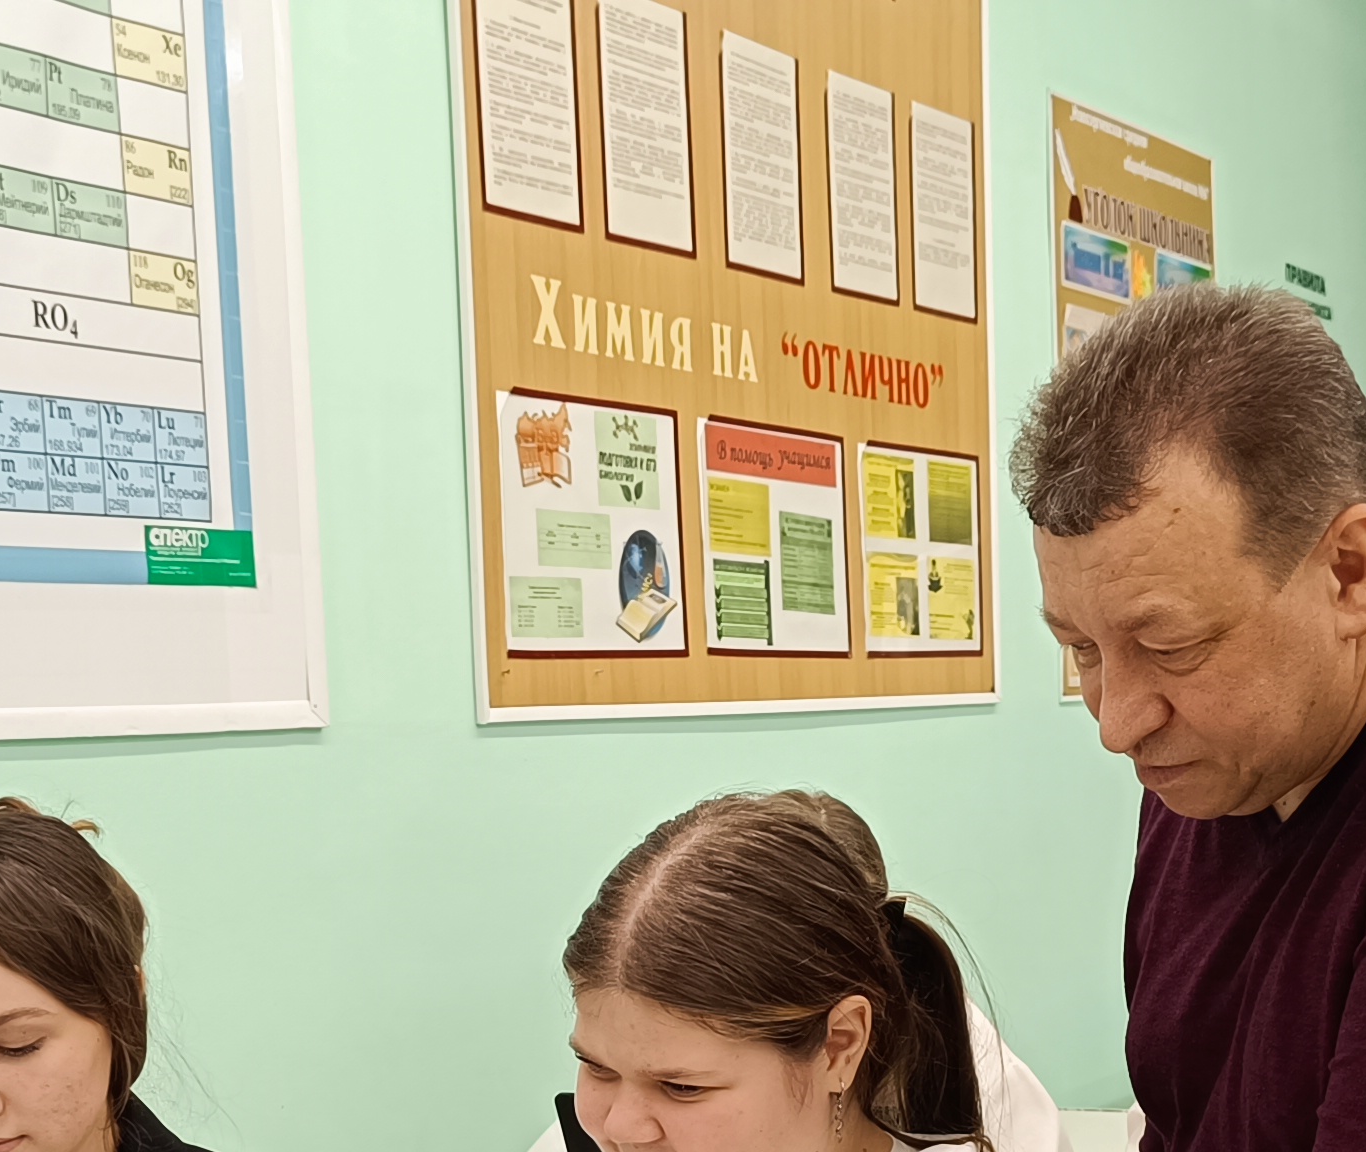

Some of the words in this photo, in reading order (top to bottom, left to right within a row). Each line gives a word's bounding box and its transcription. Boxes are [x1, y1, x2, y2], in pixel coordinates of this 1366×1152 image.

[162, 34, 182, 58] Xe
[47, 61, 63, 85] Pt
[166, 149, 189, 173] Rn
[54, 180, 78, 205] Ds
[173, 261, 196, 290] Og
[530, 273, 694, 373] ХИМИЯ
[711, 321, 759, 383] НА
[45, 399, 73, 421] Tm
[102, 404, 124, 426] Yb
[156, 410, 176, 431] Lu
[49, 456, 77, 478] Md
[730, 446, 774, 471] помощь
[777, 448, 831, 471] учащимся
[106, 460, 130, 482] No
